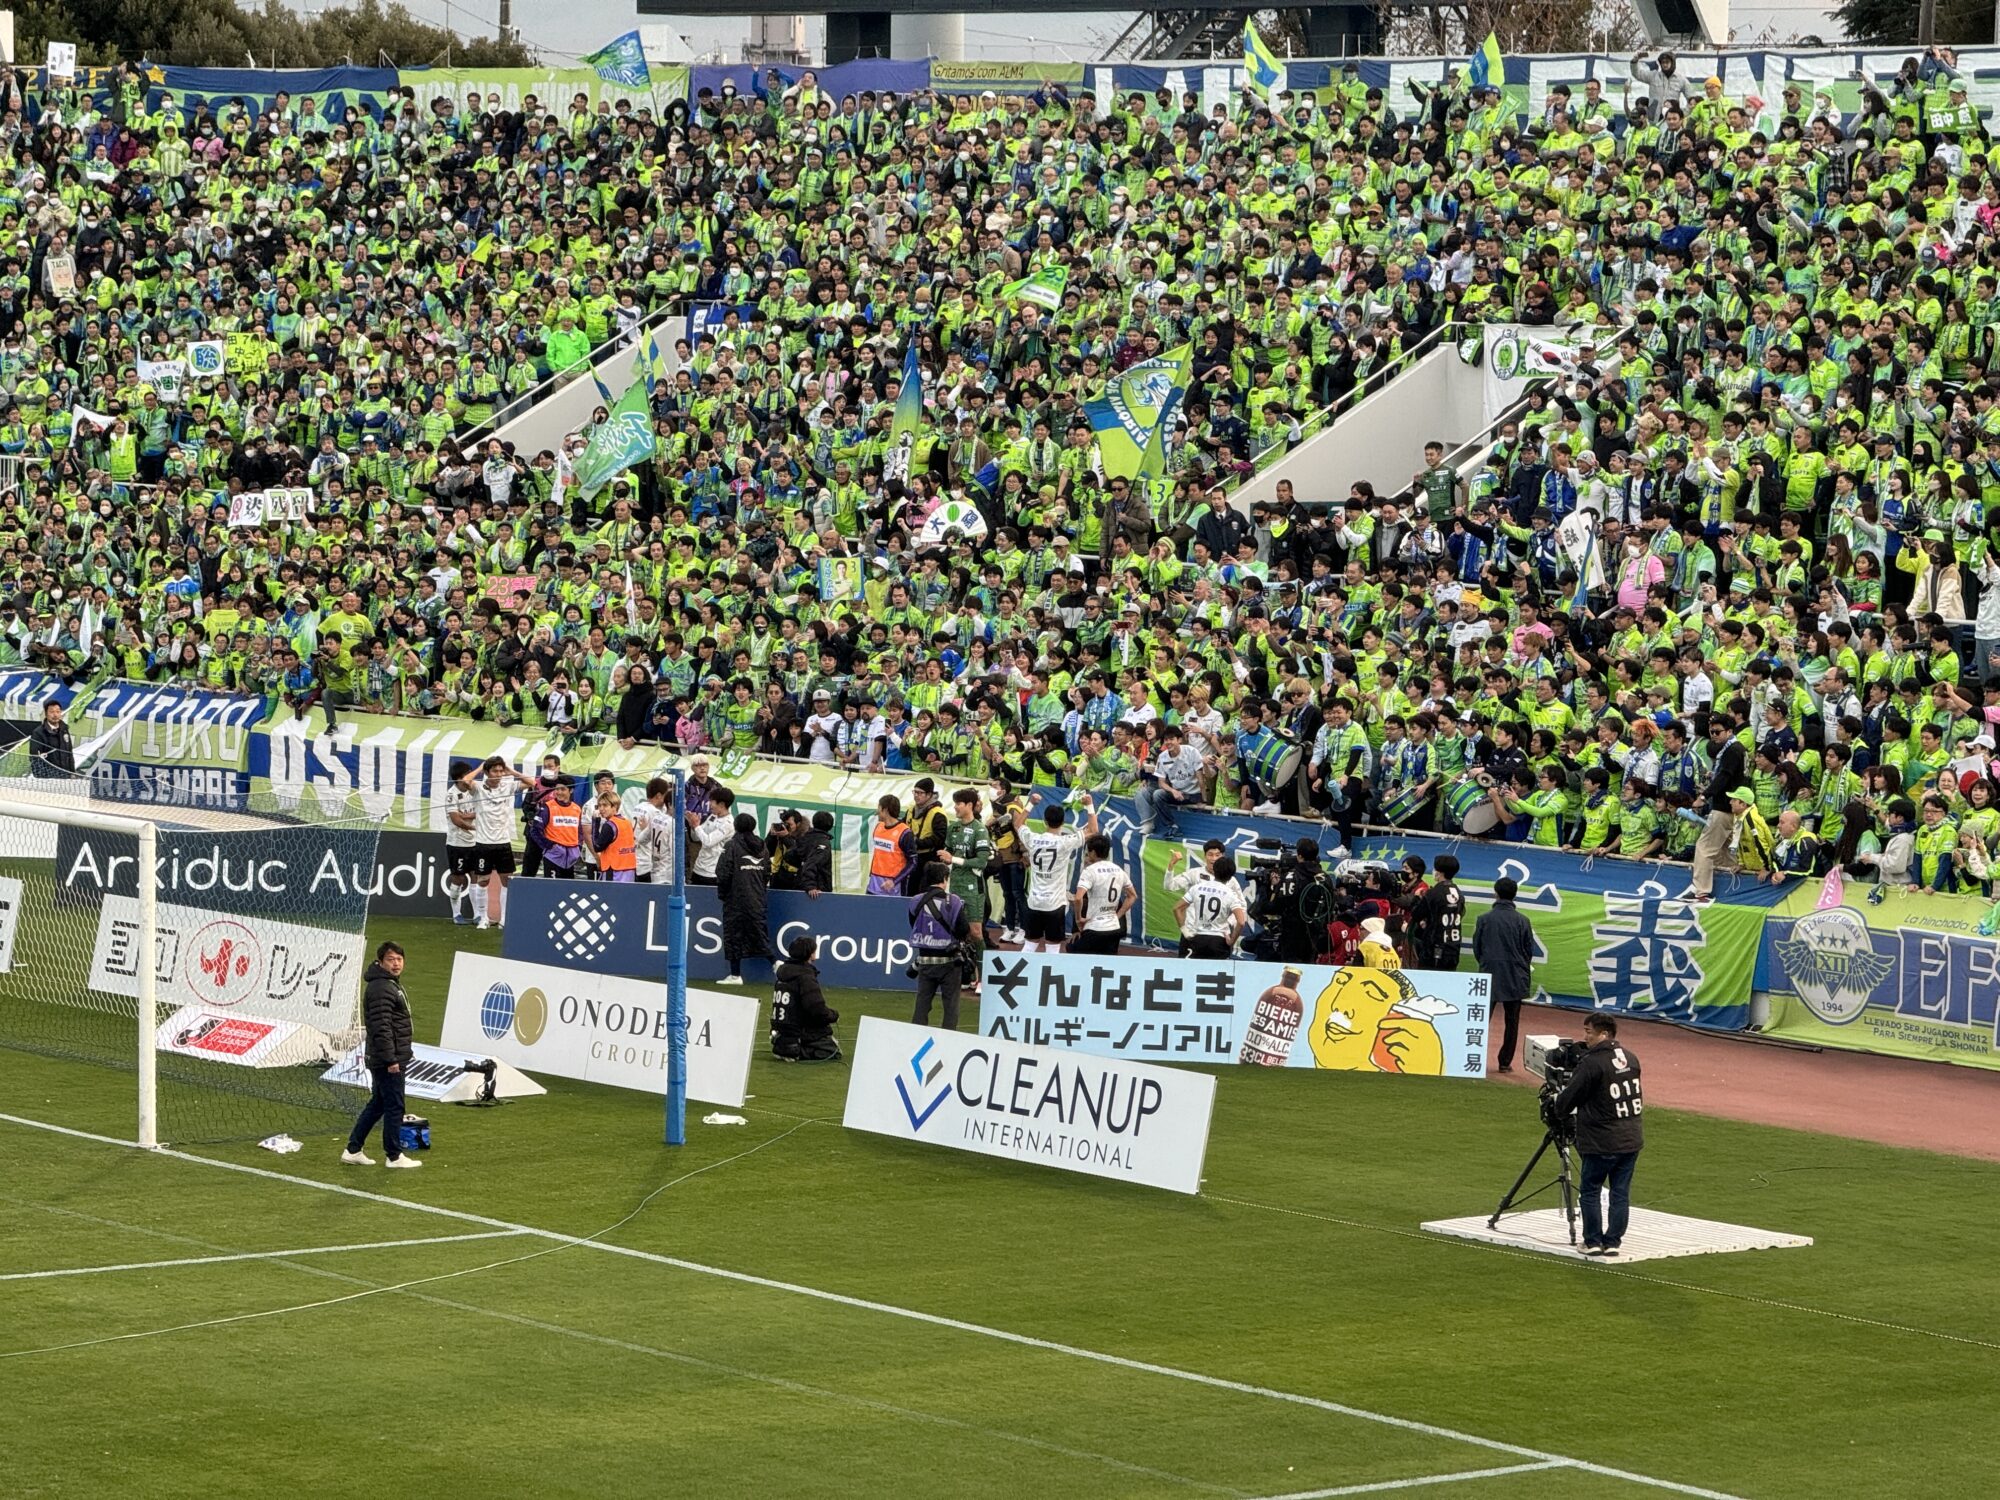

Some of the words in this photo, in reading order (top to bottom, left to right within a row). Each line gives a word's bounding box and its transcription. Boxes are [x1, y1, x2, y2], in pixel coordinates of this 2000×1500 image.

[934, 65, 975, 79] Gritamos
[977, 66, 997, 78] com
[999, 66, 1024, 79] ALMA
[1155, 483, 1166, 503] 3
[138, 766, 239, 808] SEMPRE
[457, 858, 464, 870] 5
[478, 858, 485, 869] 8
[1033, 848, 1058, 872] 47
[1108, 877, 1118, 903] 6
[1199, 894, 1221, 923] 19
[1904, 914, 1917, 924] La
[1921, 916, 1969, 930] hinchada
[777, 919, 914, 975] Group
[1818, 955, 1847, 972] XII
[987, 956, 1235, 1014] そんなとき
[1826, 974, 1839, 983] EFS
[1258, 1001, 1300, 1025] BIERE
[1821, 1002, 1843, 1013] 1994
[988, 1014, 1232, 1054] ベルギーノンアル
[1265, 1020, 1298, 1039] AMIS
[1464, 977, 1488, 1072] 湘南貿易
[1863, 1016, 1902, 1031] LLEVADO
[1903, 1022, 1920, 1033] SER
[1921, 1025, 1961, 1041] JUGADOR
[1873, 1027, 1896, 1039] PARA
[1899, 1031, 1933, 1045] SIEMPRE
[1935, 1038, 1948, 1048] LA
[1950, 1040, 1988, 1055] SHONAN
[957, 1048, 1163, 1137] CLEANUP
[964, 1117, 1134, 1171] INTERNATIONAL
